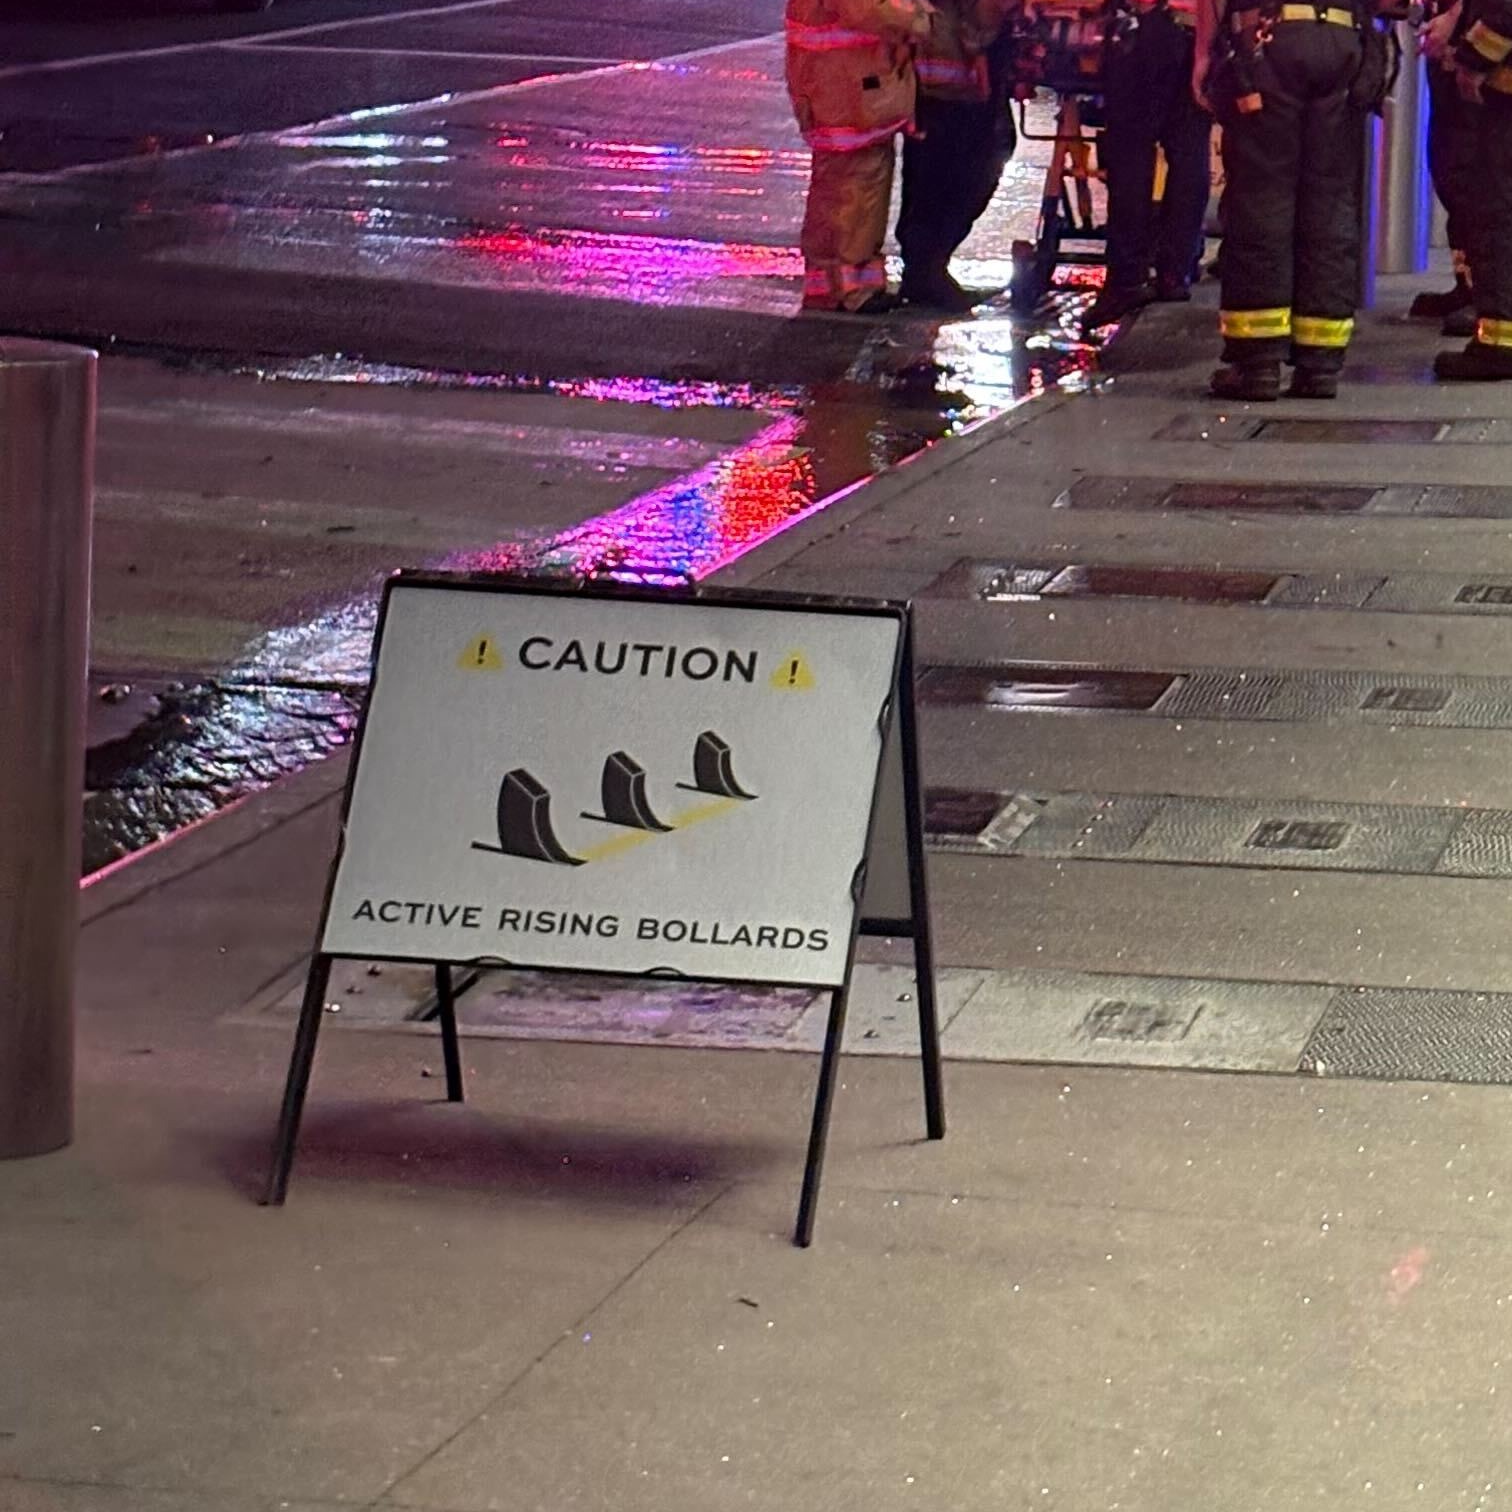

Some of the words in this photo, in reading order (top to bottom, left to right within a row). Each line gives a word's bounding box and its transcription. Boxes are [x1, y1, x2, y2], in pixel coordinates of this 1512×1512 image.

[518, 636, 758, 683] CAUTION
[352, 899, 482, 930] ACTIVE
[498, 908, 619, 939] RISING
[636, 918, 830, 952] BOLLARDS
